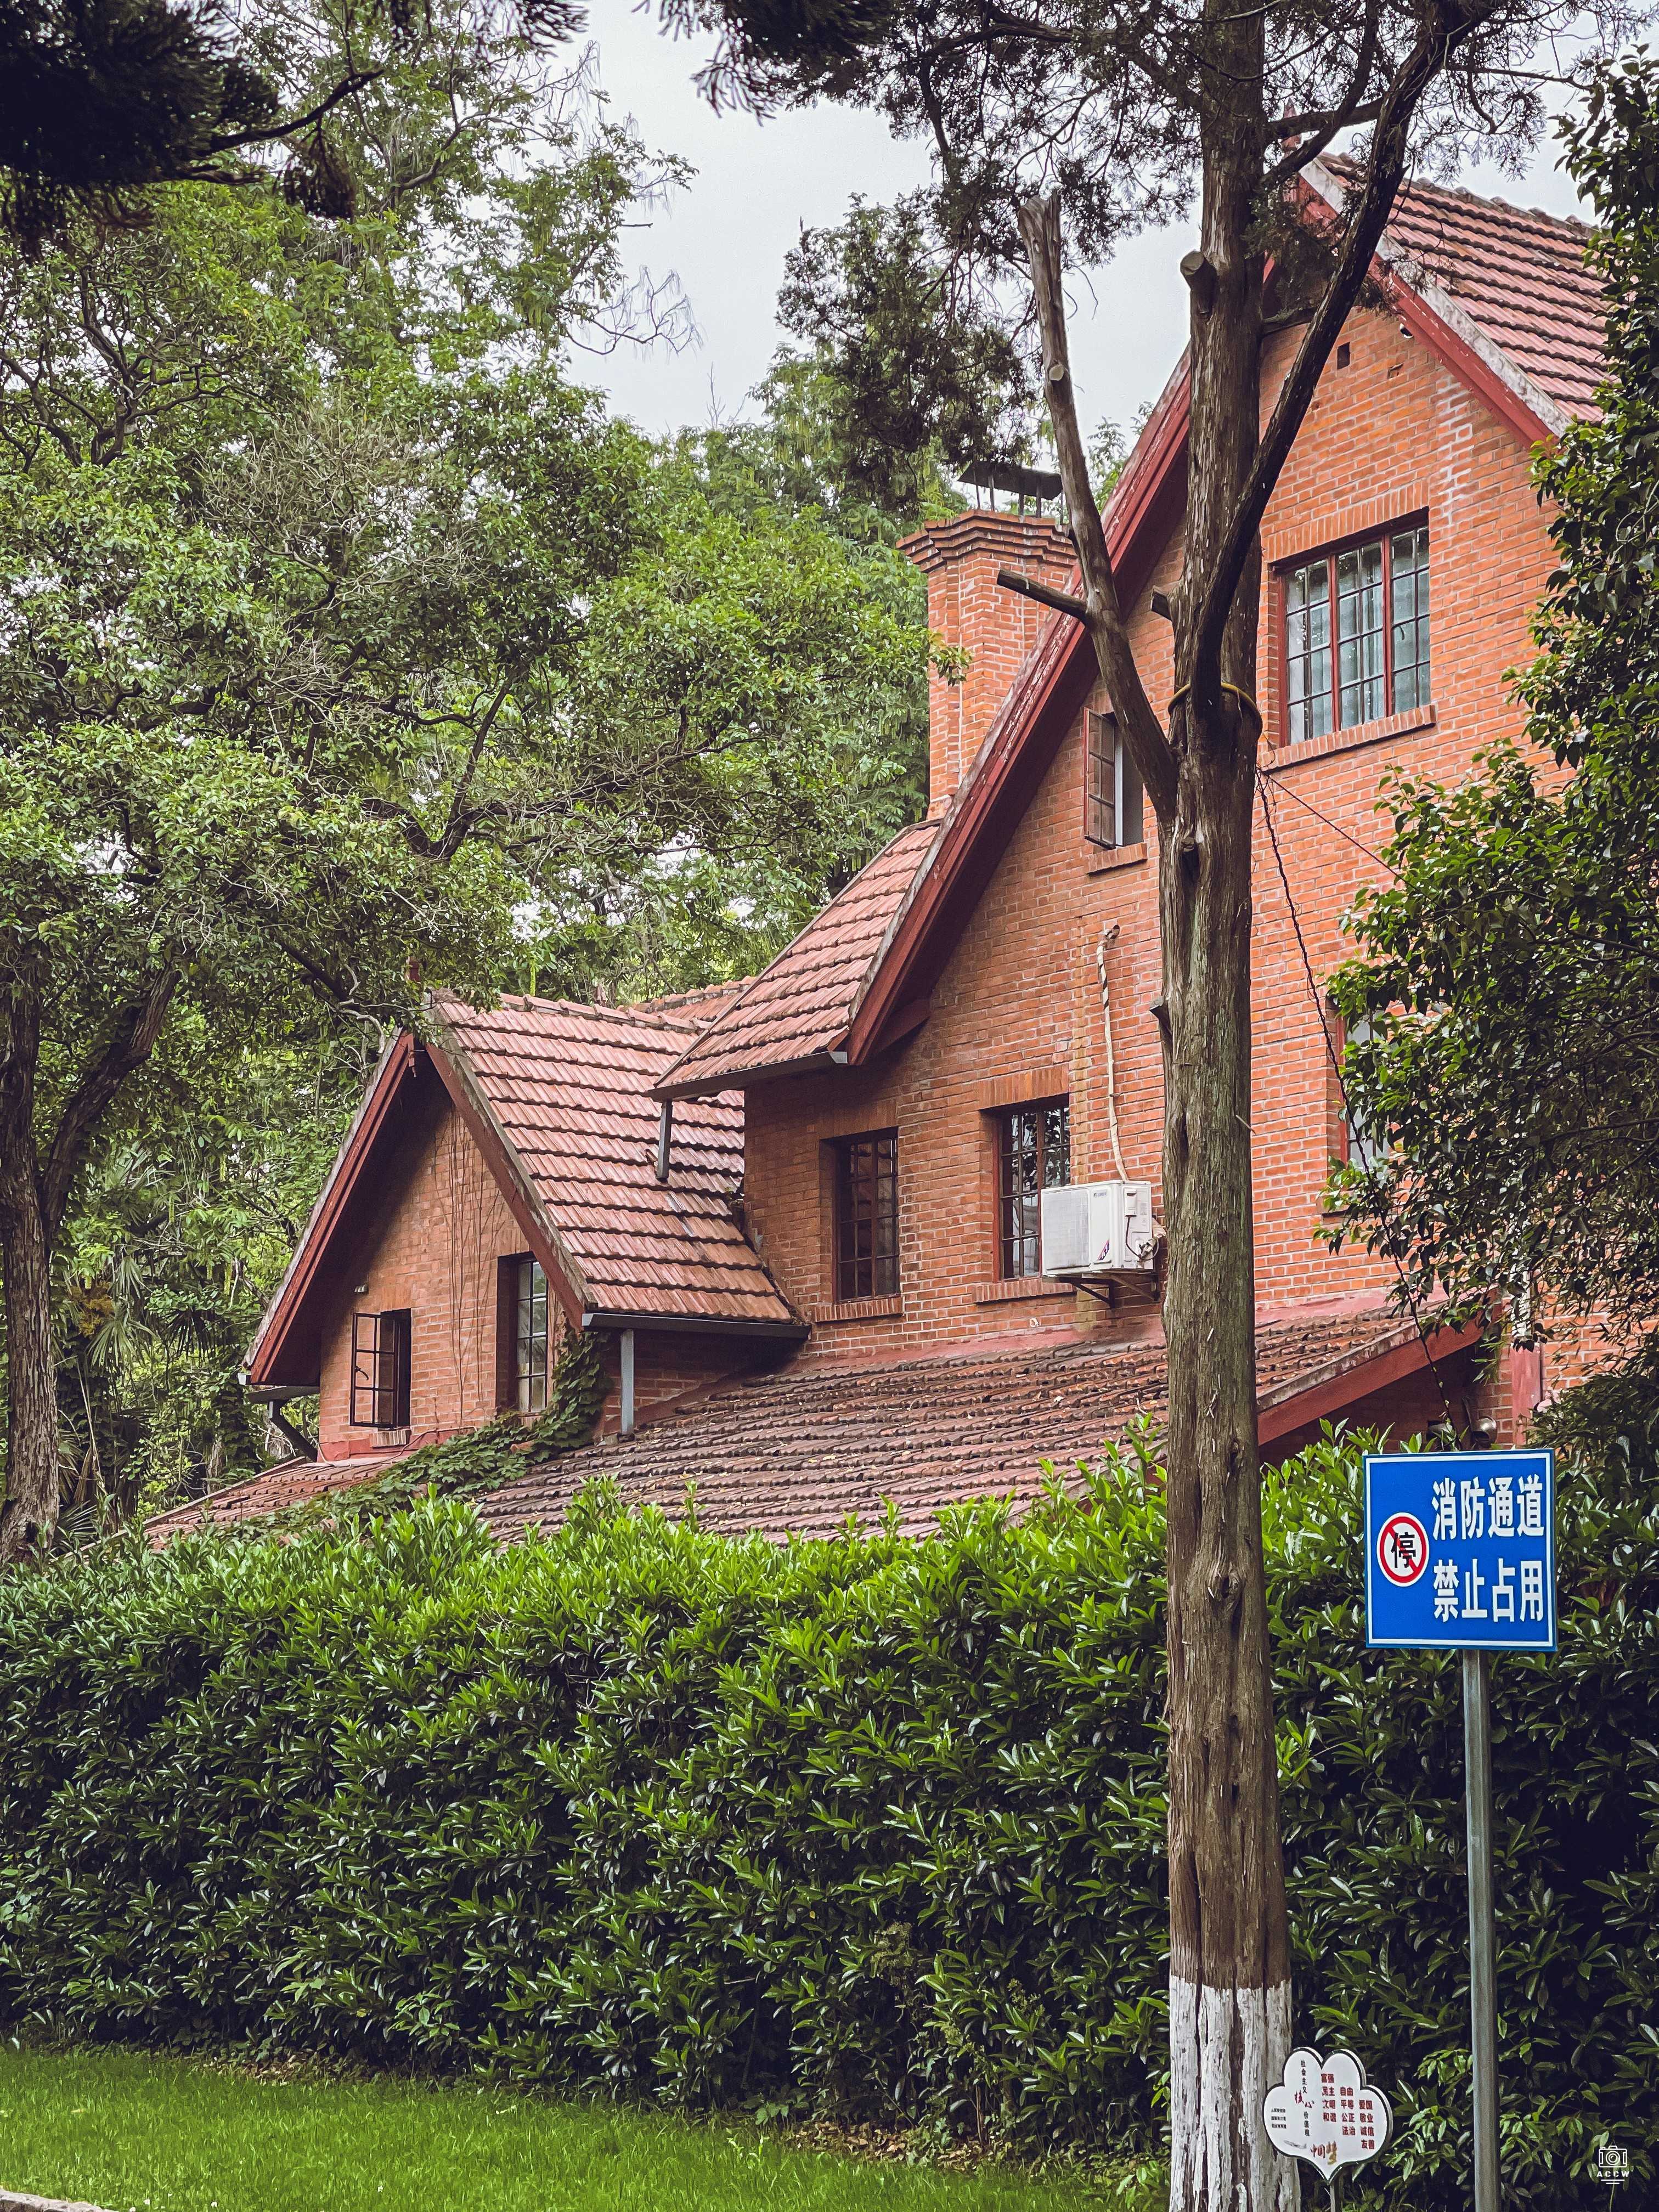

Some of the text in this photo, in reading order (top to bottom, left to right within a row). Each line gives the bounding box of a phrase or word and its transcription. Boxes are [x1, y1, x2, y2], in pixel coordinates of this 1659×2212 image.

[1431, 1474, 1544, 1541] 消防通道
[1390, 1531, 1417, 1568] 停
[1432, 1558, 1544, 1623] 禁止占用
[1321, 2073, 1334, 2083] 富强
[1322, 2086, 1353, 2096] 民主 自由
[1294, 2089, 1314, 2108] 核心
[1322, 2100, 1373, 2110] 文明 平等 爱国
[1323, 2112, 1374, 2123] 和谐 公正 敬业
[1342, 2125, 1374, 2136] 法治 诚信
[1361, 2140, 1375, 2149] 友善
